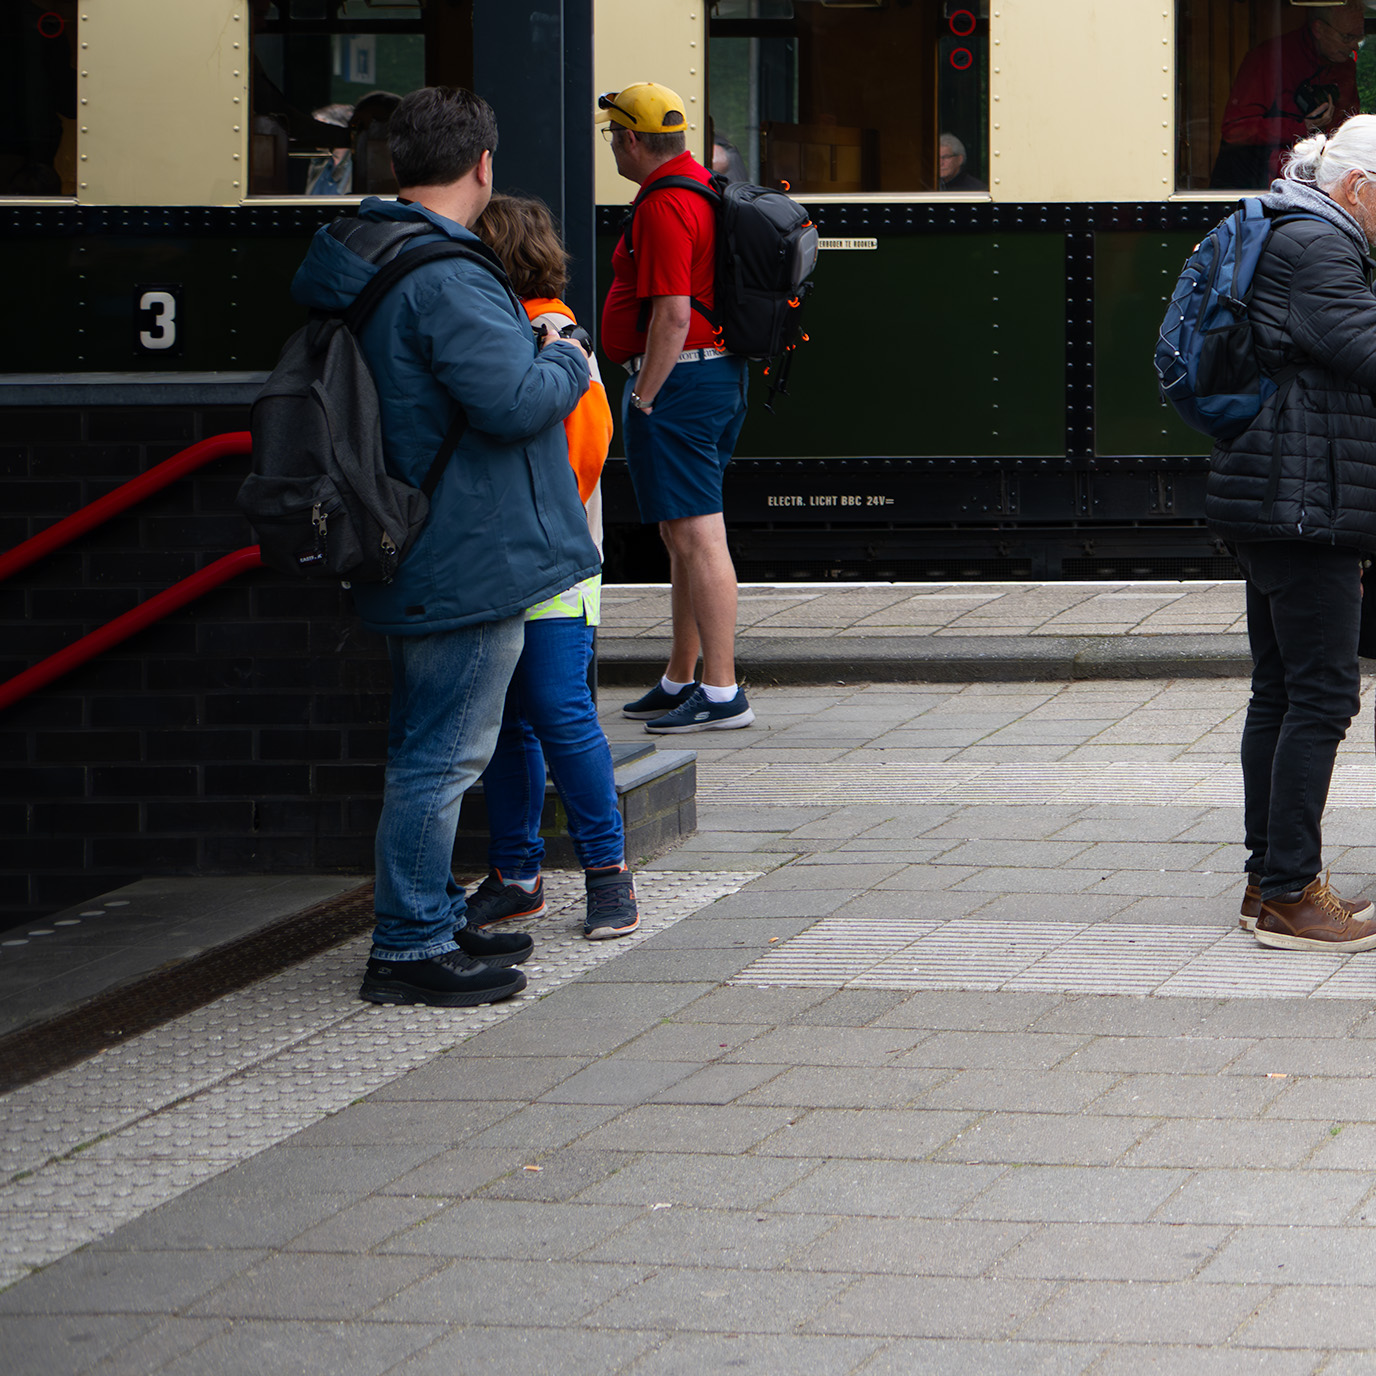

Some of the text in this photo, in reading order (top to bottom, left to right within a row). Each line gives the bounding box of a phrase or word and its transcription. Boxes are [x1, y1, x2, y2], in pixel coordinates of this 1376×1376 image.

[845, 240, 852, 248] TE
[140, 291, 176, 350] 3
[767, 495, 895, 506] ELECTR. LICHT BBC 24V=
